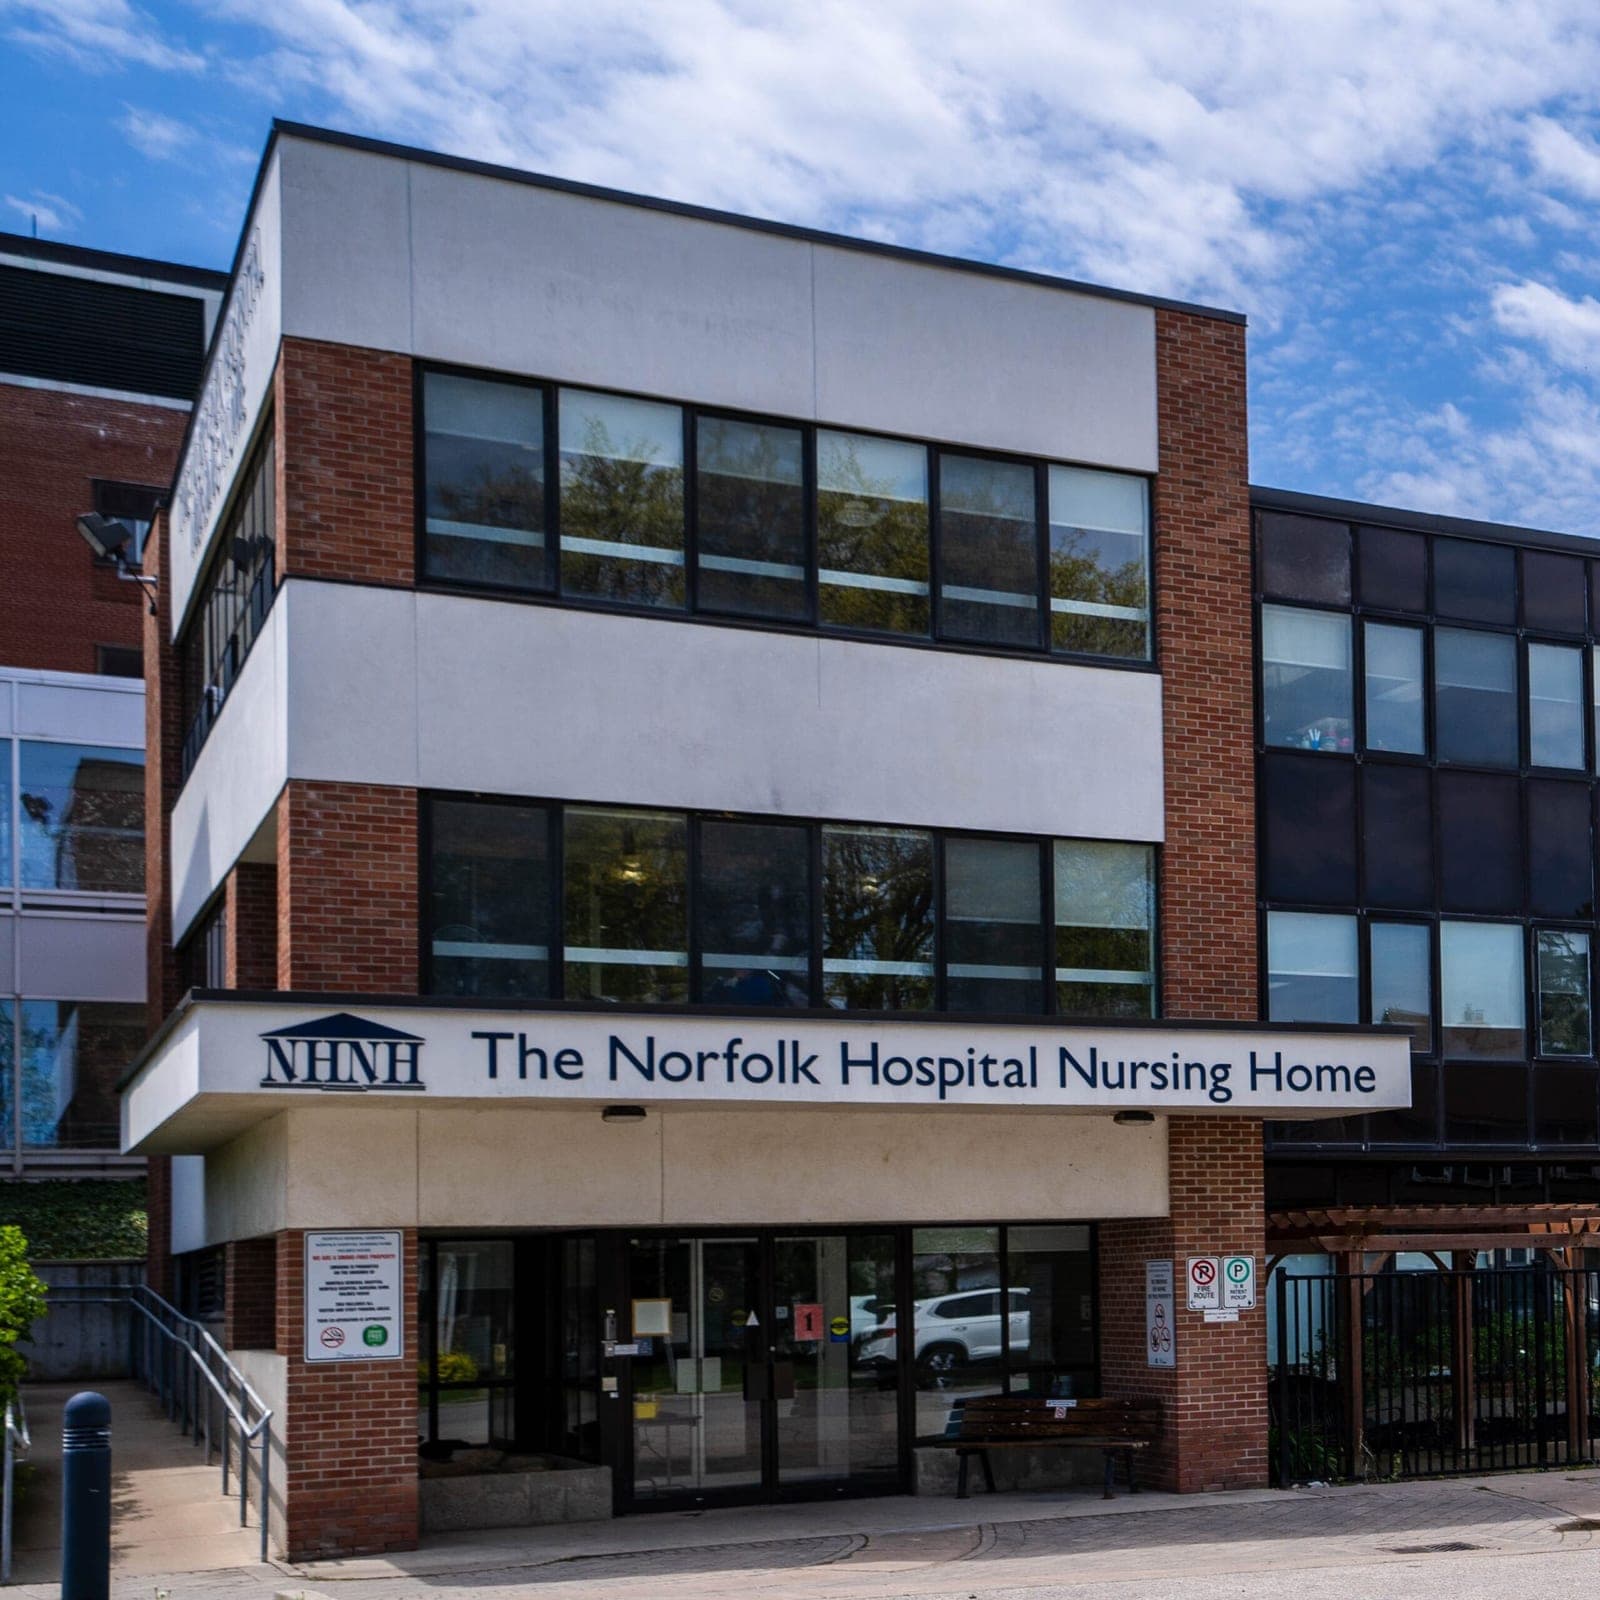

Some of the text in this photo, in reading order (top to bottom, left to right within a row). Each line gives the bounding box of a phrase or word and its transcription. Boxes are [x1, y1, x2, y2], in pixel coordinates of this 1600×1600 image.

[261, 1038, 426, 1084] NHNH
[471, 1031, 1376, 1104] The Norfolk Hospital Nursing Home
[1234, 1264, 1243, 1278] P
